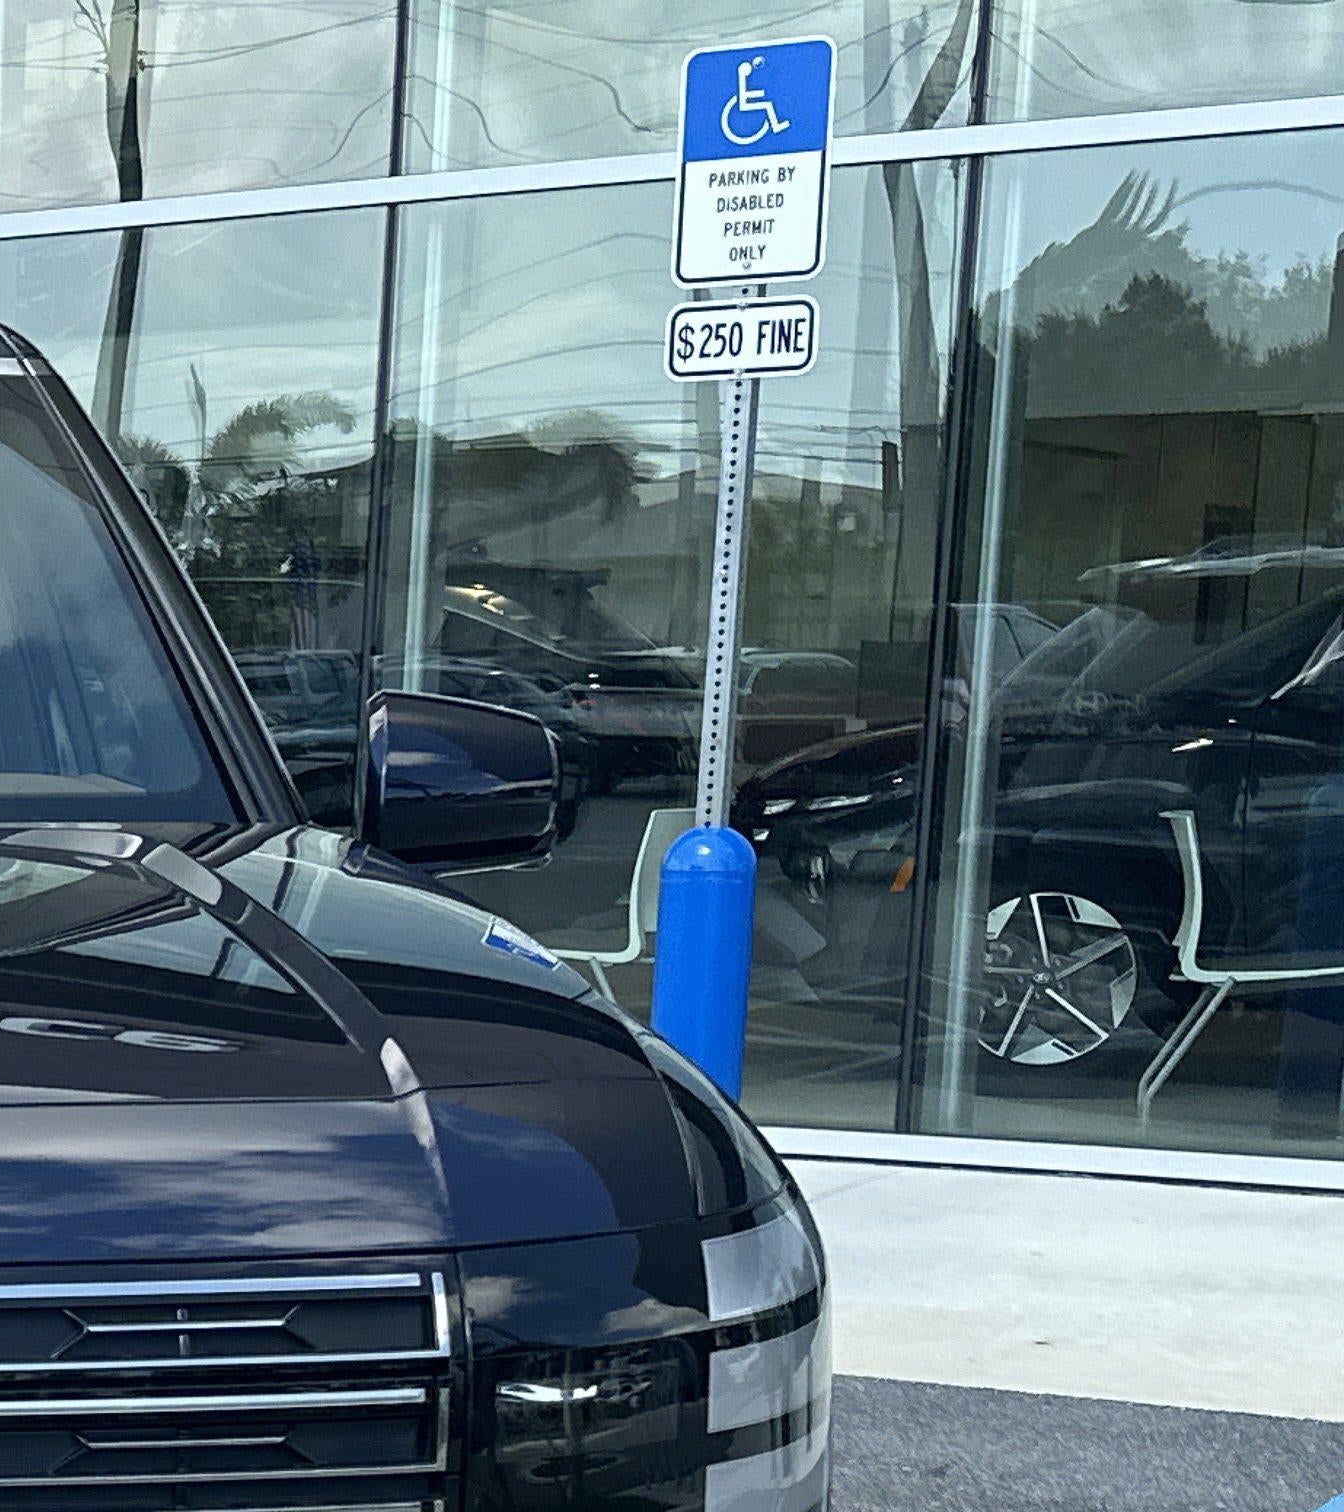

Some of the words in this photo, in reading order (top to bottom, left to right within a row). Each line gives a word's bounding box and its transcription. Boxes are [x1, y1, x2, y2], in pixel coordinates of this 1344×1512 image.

[709, 168, 770, 188] PARKING
[777, 166, 796, 182] BY
[716, 193, 785, 213] DISABLED
[723, 219, 775, 237] PERMIT
[729, 245, 766, 262] ONLY
[676, 322, 744, 363] $250
[756, 318, 807, 356] FINE
